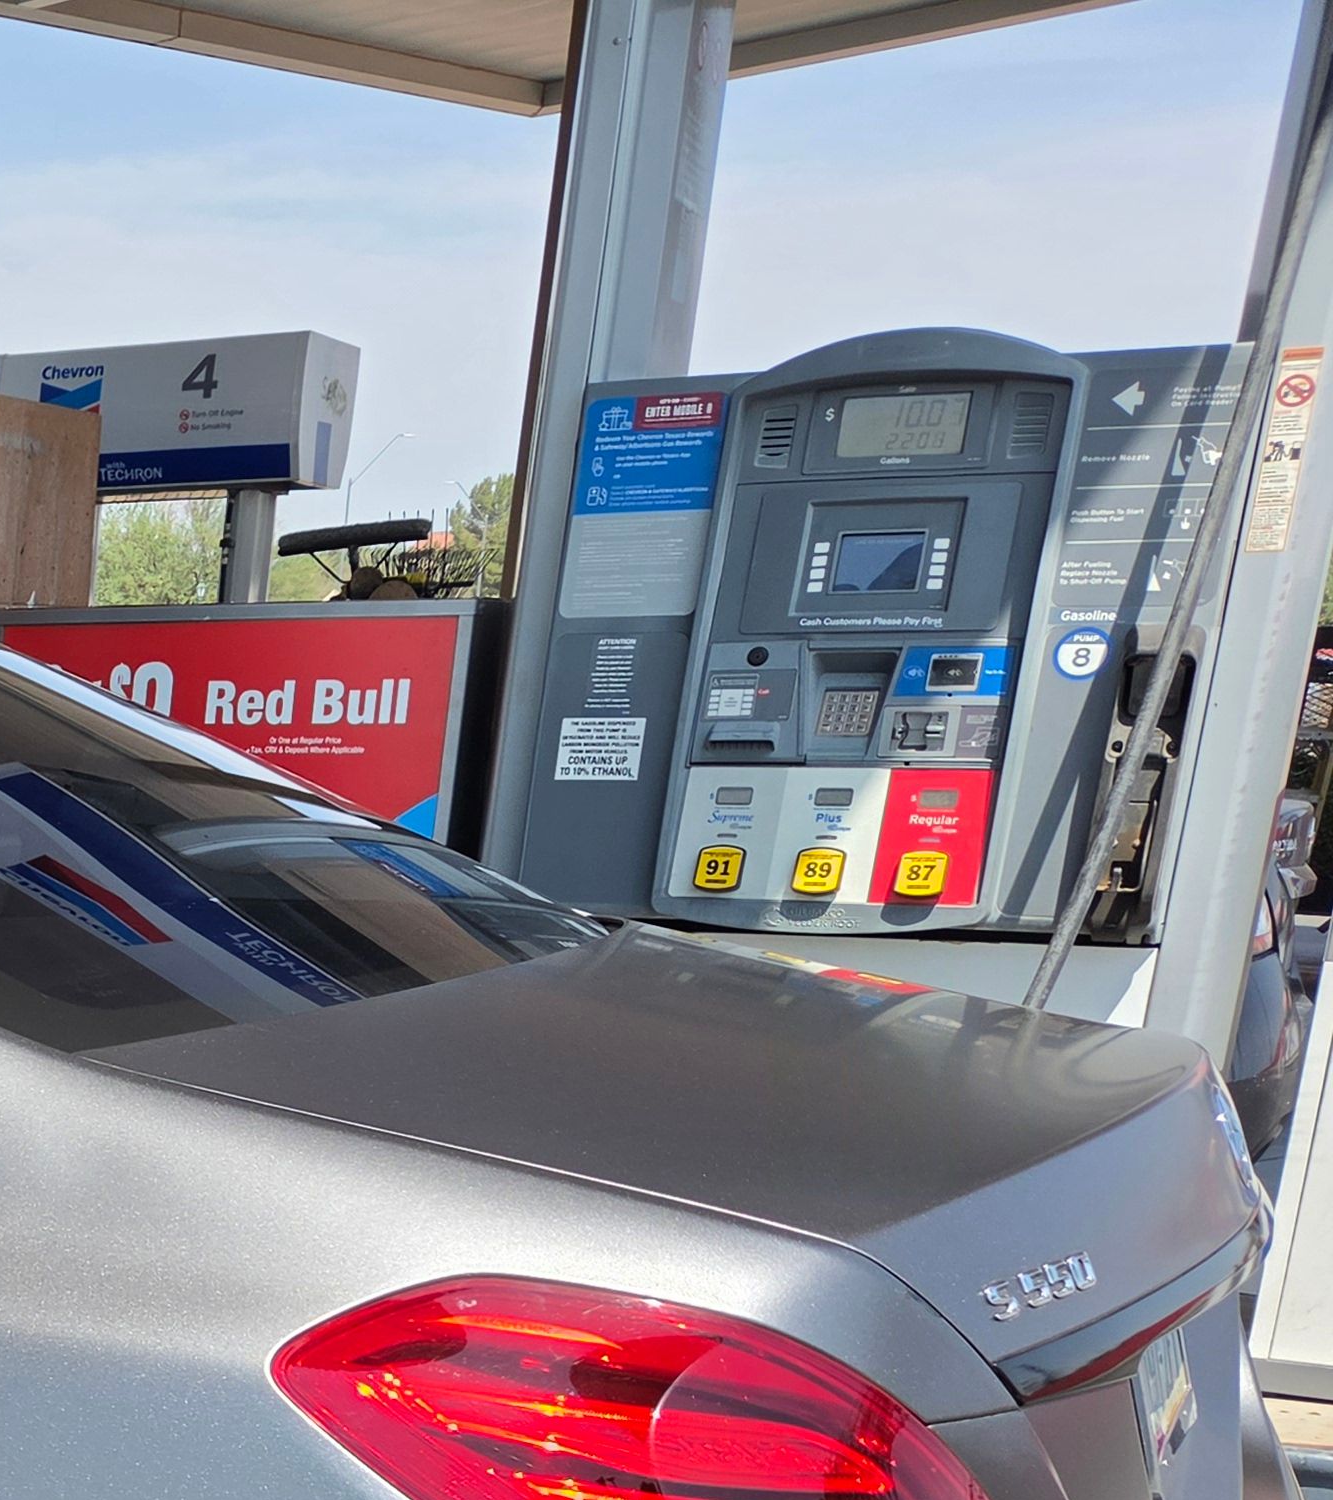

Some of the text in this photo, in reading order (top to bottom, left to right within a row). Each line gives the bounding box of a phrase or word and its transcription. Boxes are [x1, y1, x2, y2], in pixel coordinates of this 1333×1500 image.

[41, 365, 105, 381] Chevron
[181, 353, 219, 399] 4
[191, 408, 244, 419] Turn Off Engine
[824, 407, 836, 422] $
[201, 422, 232, 432] Smoking
[879, 456, 911, 465] Gallons
[1081, 453, 1151, 463] Remove Nozzle
[106, 461, 126, 470] with
[99, 467, 164, 482] TECHRON
[1084, 561, 1111, 569] Fueling
[1060, 569, 1089, 577] Replace
[1105, 578, 1127, 586] Pump
[799, 615, 943, 627] Cash Customers Please Pay First
[1061, 610, 1117, 622] Gasoline
[1073, 634, 1101, 642] PUMP
[1072, 647, 1091, 668] 8
[204, 678, 411, 725] Red Bull
[268, 736, 277, 745] Or
[278, 736, 291, 745] One
[299, 736, 324, 746] Regular
[325, 736, 342, 745] Price
[567, 756, 629, 765] CONTAINS UP
[560, 767, 571, 776] TO
[573, 767, 590, 776] 10%
[707, 810, 755, 824] Supreme
[815, 813, 842, 823] Plus
[909, 814, 960, 826] Regular
[705, 859, 730, 876] 91
[803, 861, 832, 878] 89
[906, 865, 937, 881] 87
[982, 1250, 1098, 1321] S 550
